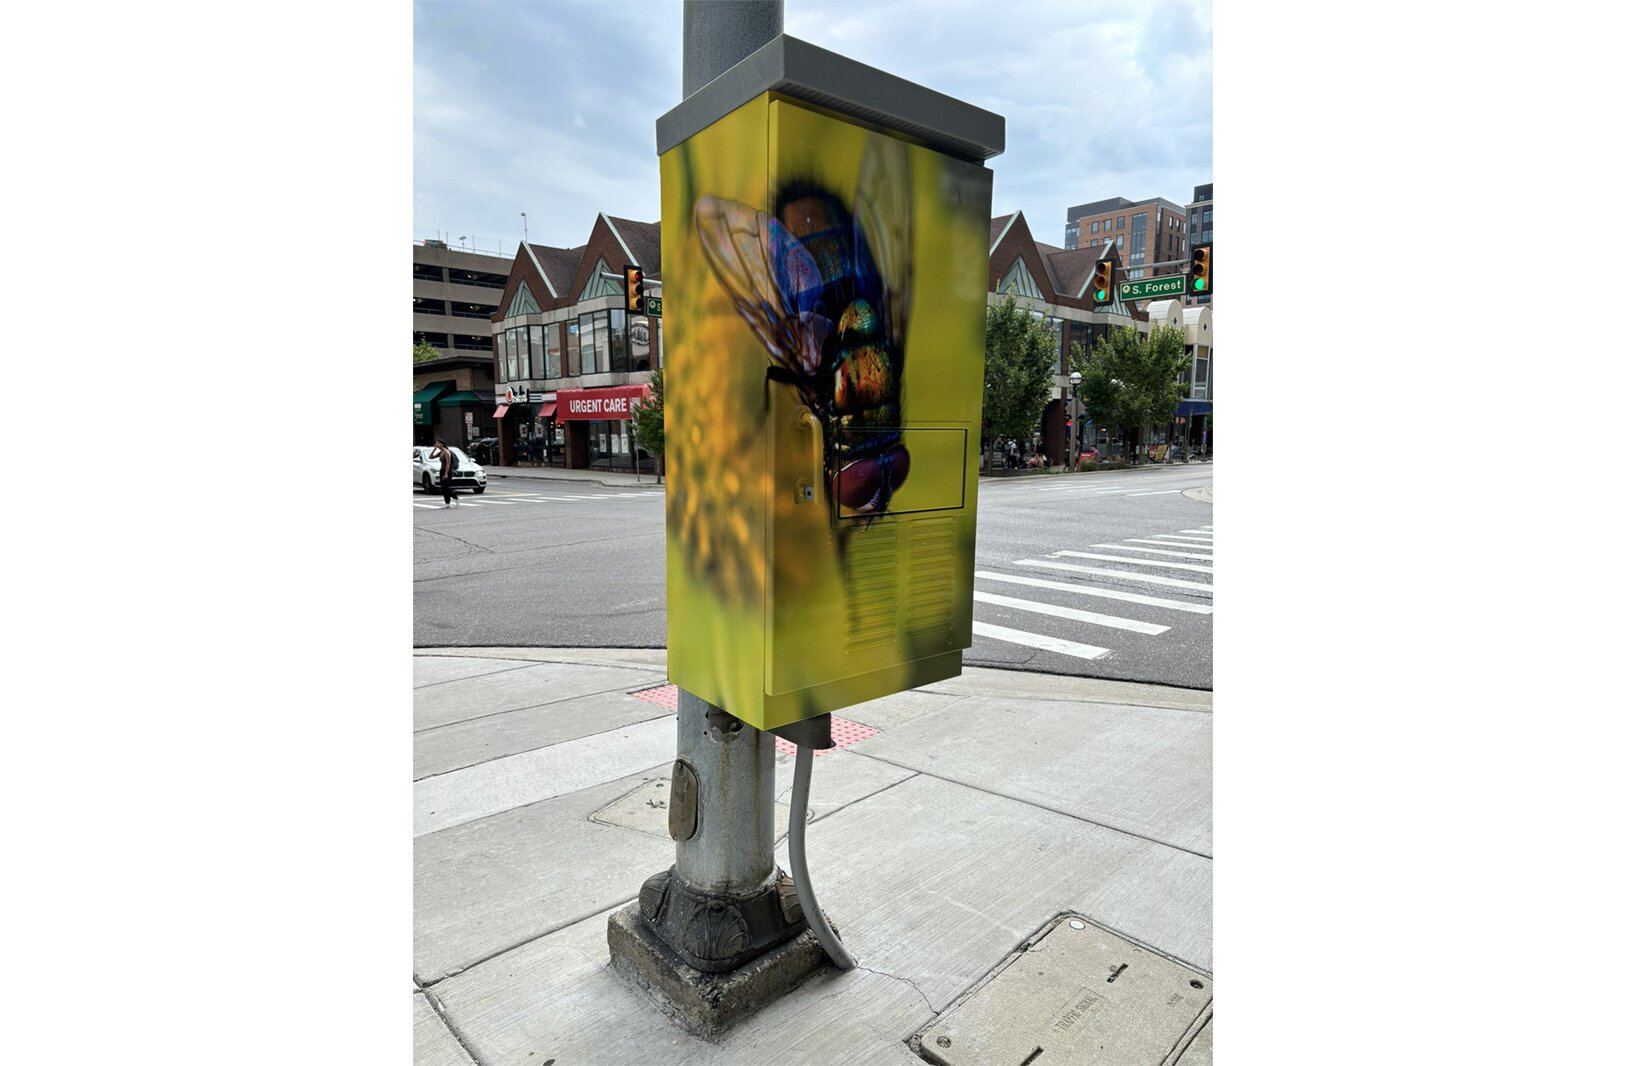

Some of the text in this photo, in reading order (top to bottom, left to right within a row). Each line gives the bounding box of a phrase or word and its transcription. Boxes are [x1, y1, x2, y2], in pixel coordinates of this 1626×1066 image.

[1132, 280, 1181, 295] S. Forest
[569, 400, 602, 413] URGENT
[603, 398, 627, 412] CARE
[1054, 1009, 1082, 1031] TRAFFIC
